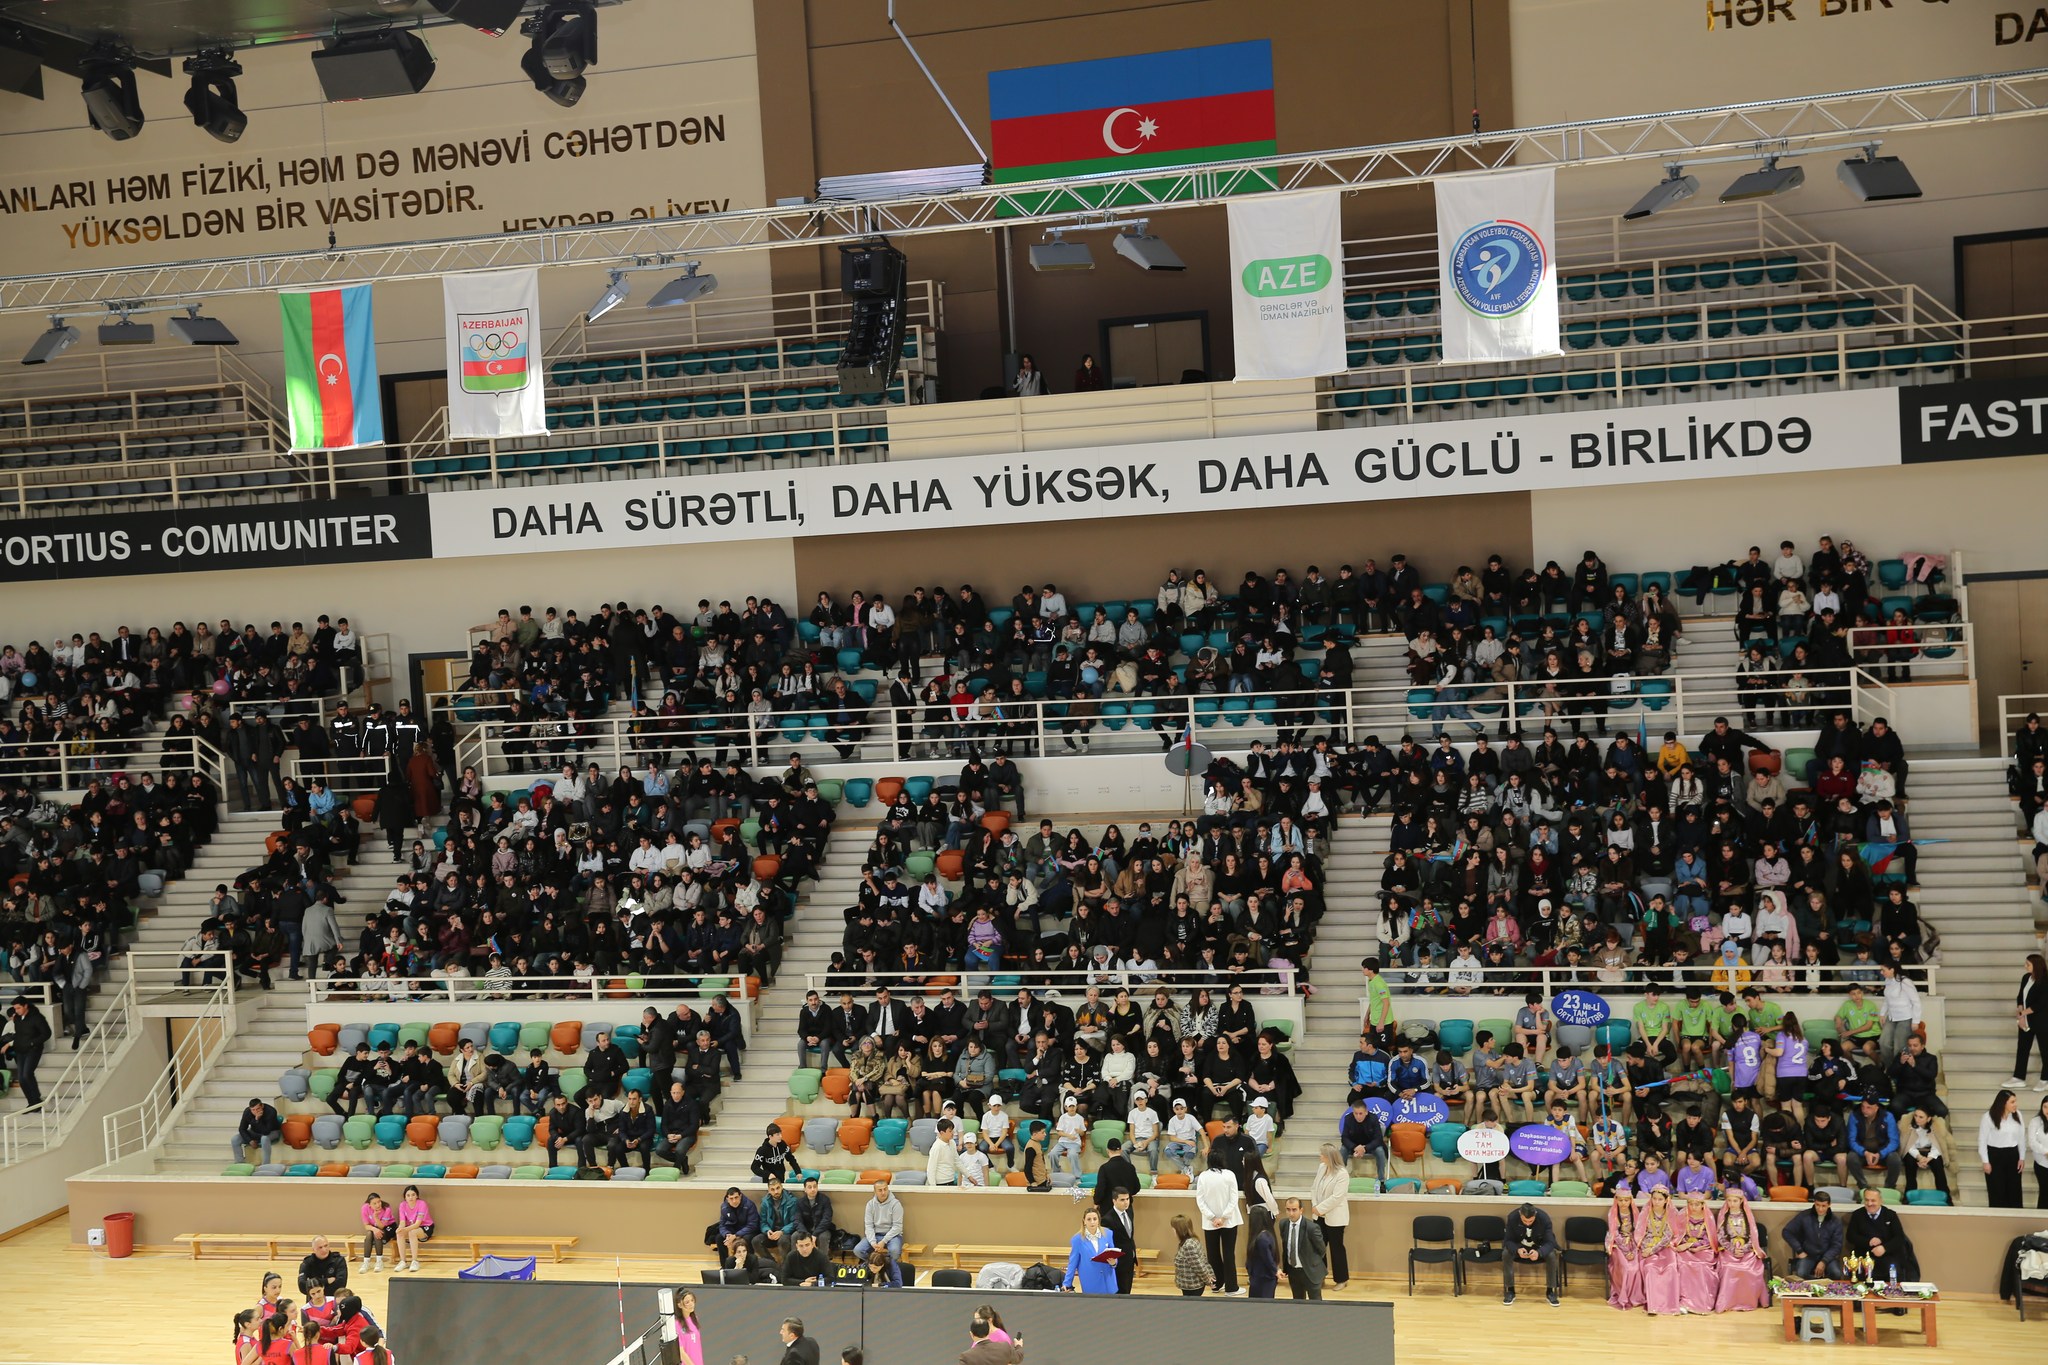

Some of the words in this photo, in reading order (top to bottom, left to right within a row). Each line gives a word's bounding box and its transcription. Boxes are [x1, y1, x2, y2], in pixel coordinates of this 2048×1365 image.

[107, 173, 171, 204] HƏM
[182, 157, 271, 197] FİZİKİ,
[278, 155, 345, 187] HƏM
[356, 150, 400, 179] DƏ
[412, 129, 531, 174] MƏNƏVİ
[543, 114, 726, 160] CƏHƏTDƏN
[61, 207, 245, 249] YÜKSƏLDƏN
[256, 197, 308, 232] BİR
[315, 180, 484, 226] VASİTƏDİR.
[1479, 227, 1509, 239] VOLEYBOL
[1258, 261, 1316, 291] AZE
[1481, 300, 1518, 312] VOLLEYBALL
[1516, 269, 1539, 303] FEDERATION
[1260, 301, 1303, 312] GƏNCLƏR
[1305, 300, 1318, 308] VƏ
[463, 317, 523, 329] AZERBAIJAN
[1260, 312, 1289, 321] İDMAN
[1921, 397, 2048, 442] FAST
[492, 501, 604, 539] DAHA
[624, 480, 805, 532] SÜRƏTLİ,
[832, 478, 952, 517] DAHA
[972, 464, 1170, 508] YÜKSƏK,
[1198, 452, 1329, 494] DAHA
[1354, 431, 1521, 484] GÜCLÜ
[1570, 416, 1812, 470] BİRLİKDƏ
[0, 530, 131, 565] ORTIUS
[161, 513, 400, 558] COMMUNITER
[1563, 994, 1581, 1009] 23
[1556, 1008, 1574, 1023] ORTA
[1575, 1012, 1605, 1025] MƏKTƏB
[1573, 1009, 1588, 1017] TAM
[1380, 1033, 1386, 1042] 2
[1743, 1046, 1758, 1067] 8
[1791, 1043, 1805, 1064] 2
[1401, 1098, 1417, 1114] 31
[838, 1268, 846, 1278] 0
[857, 1269, 866, 1278] 0
